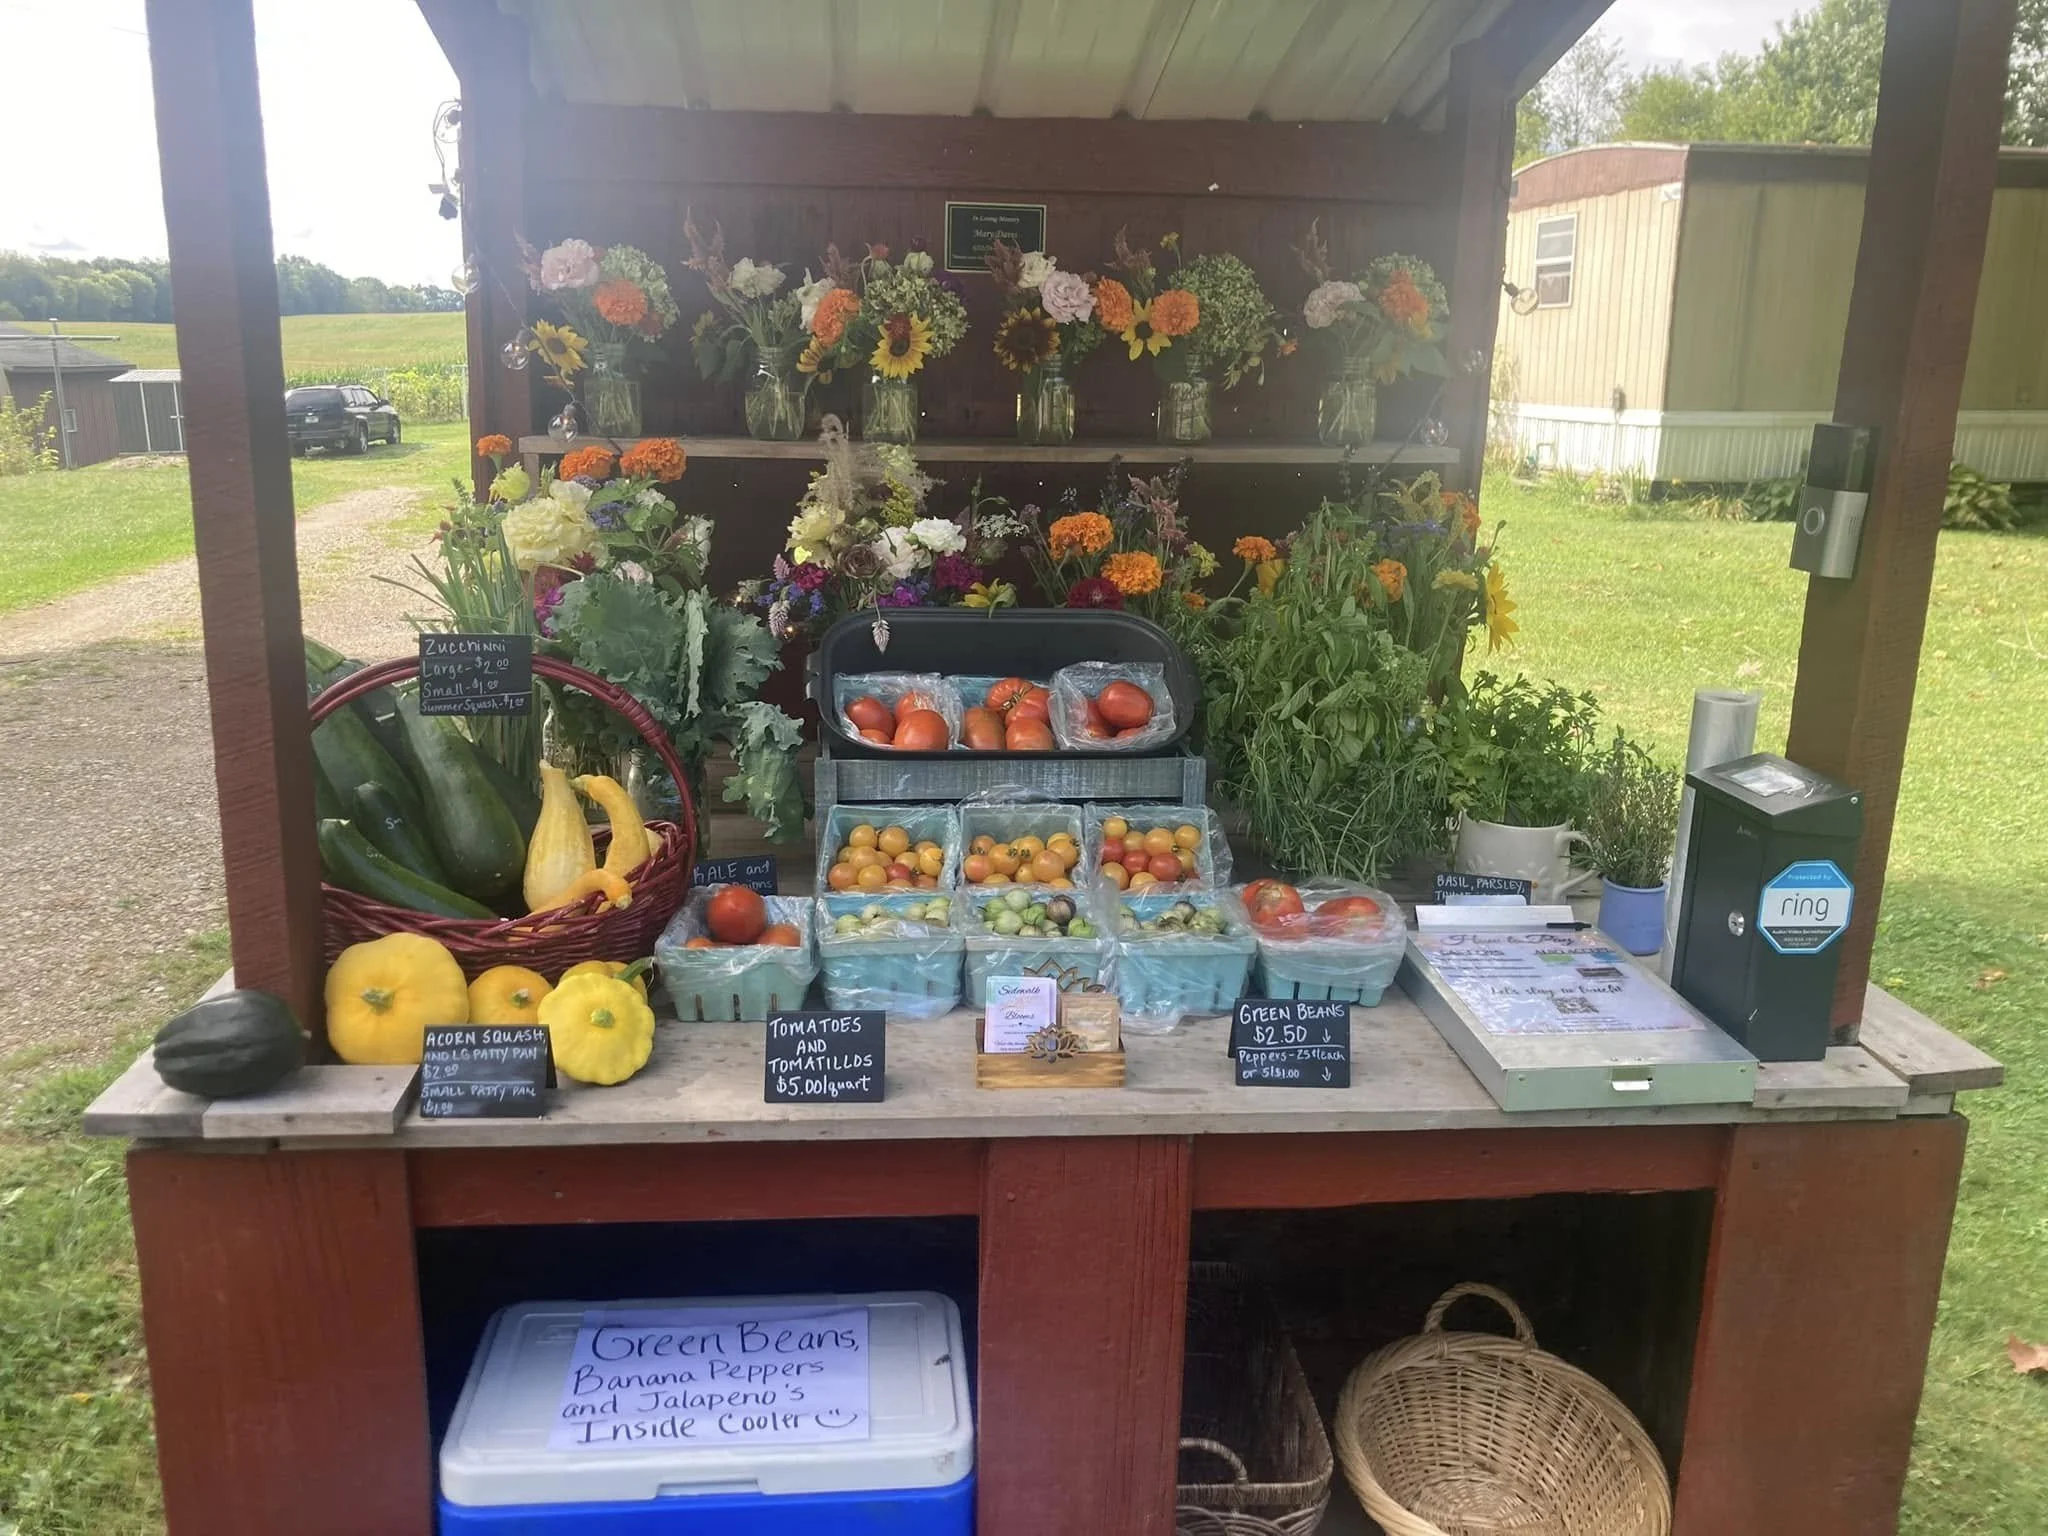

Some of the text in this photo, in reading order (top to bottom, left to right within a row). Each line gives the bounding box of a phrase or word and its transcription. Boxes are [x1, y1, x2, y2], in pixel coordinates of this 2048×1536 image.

[693, 860, 770, 884] KALE and
[1781, 893, 1829, 921] ring
[1525, 934, 1574, 946] Pay
[1297, 1003, 1345, 1020] BEANS
[769, 1017, 861, 1038] TOMATOES
[1253, 1024, 1307, 1045] $2.50
[426, 1031, 476, 1047] ACORN
[796, 1039, 827, 1056] AND
[424, 1047, 537, 1064] AND LG PATTY PAN
[768, 1054, 873, 1074] TOMATILLOS
[421, 1086, 464, 1098] SMALL
[471, 1086, 508, 1102] PATTY
[592, 1321, 859, 1361] Green Beans,
[573, 1359, 824, 1396] Banana Peppers
[562, 1384, 804, 1418] and Jalapeno's
[571, 1413, 806, 1444] Inside Cooler
